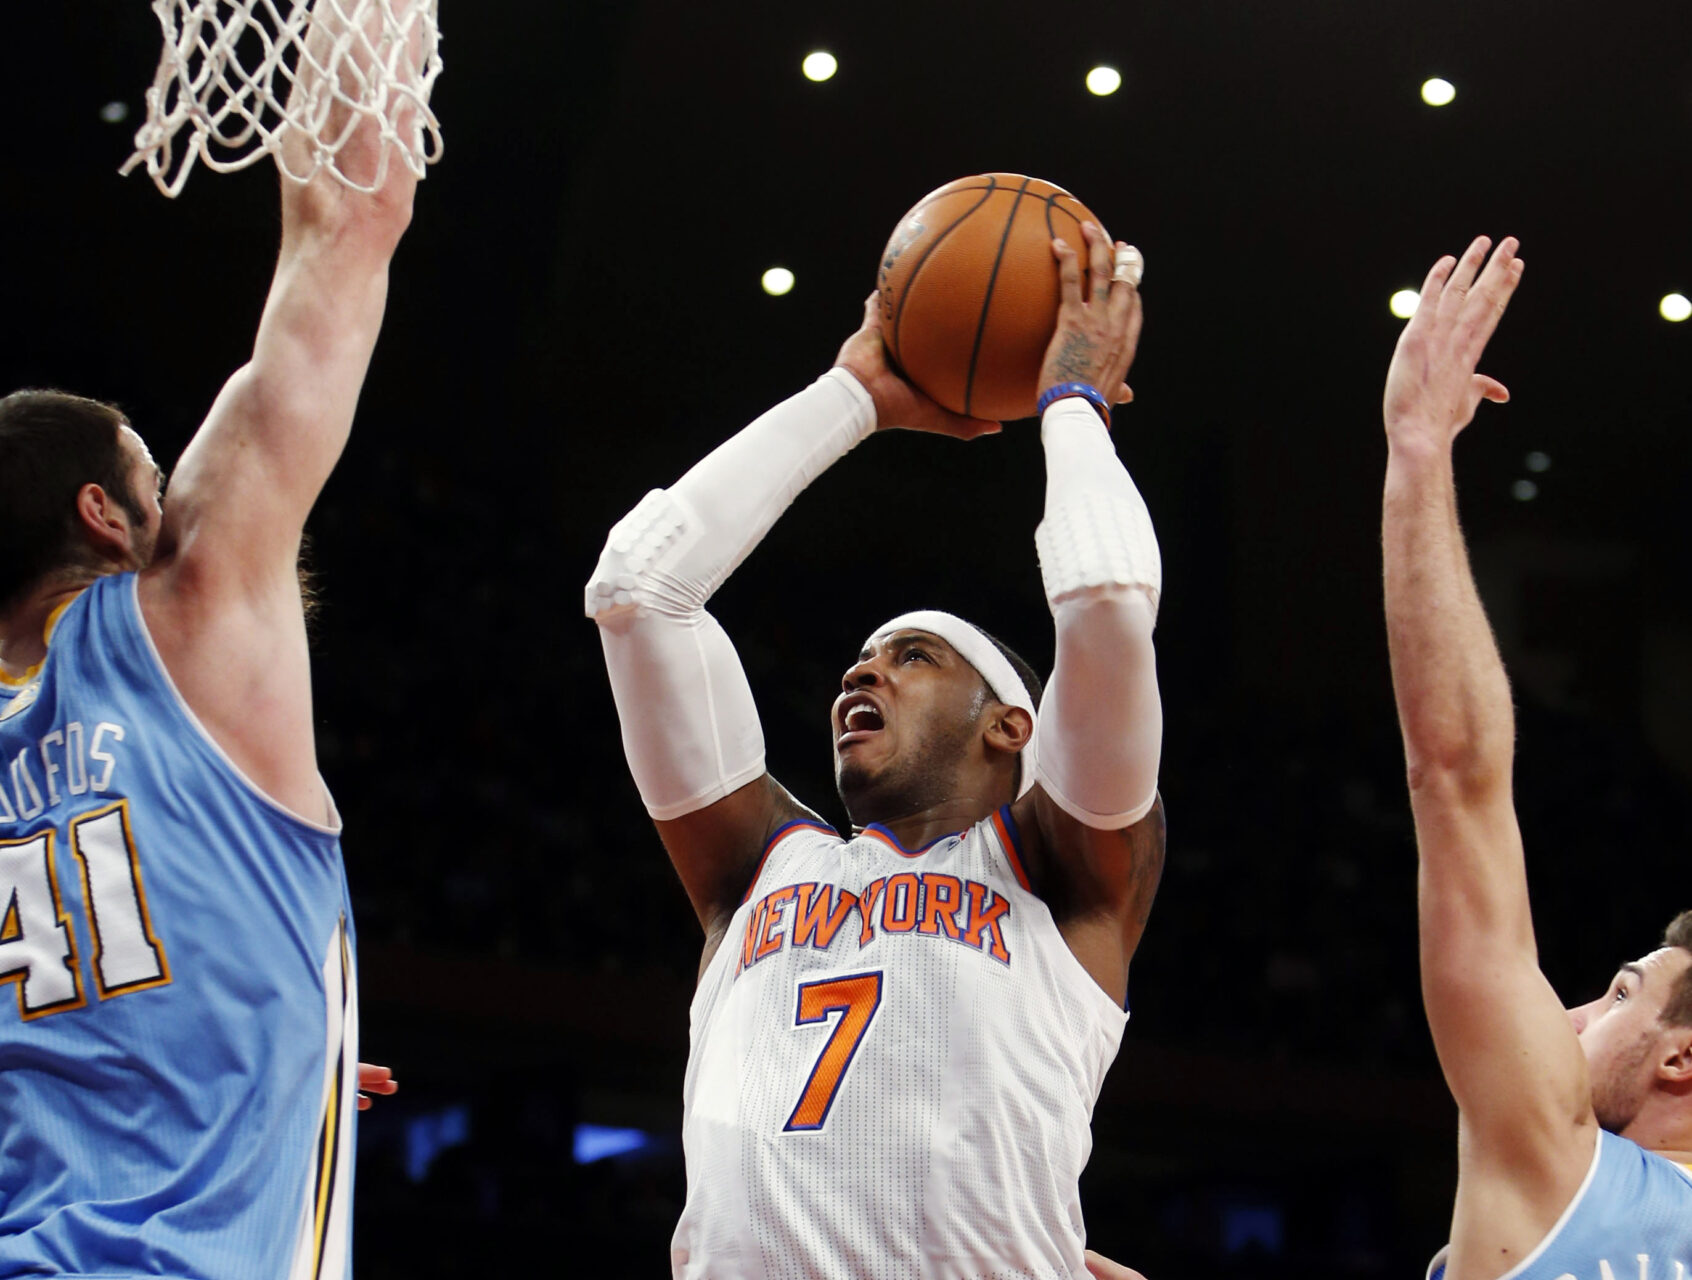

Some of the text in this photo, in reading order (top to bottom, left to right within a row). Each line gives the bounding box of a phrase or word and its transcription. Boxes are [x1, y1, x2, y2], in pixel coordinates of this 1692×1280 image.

[0, 798, 172, 1022] 41
[734, 873, 1011, 981] NEW YORK
[781, 970, 884, 1133] 7
